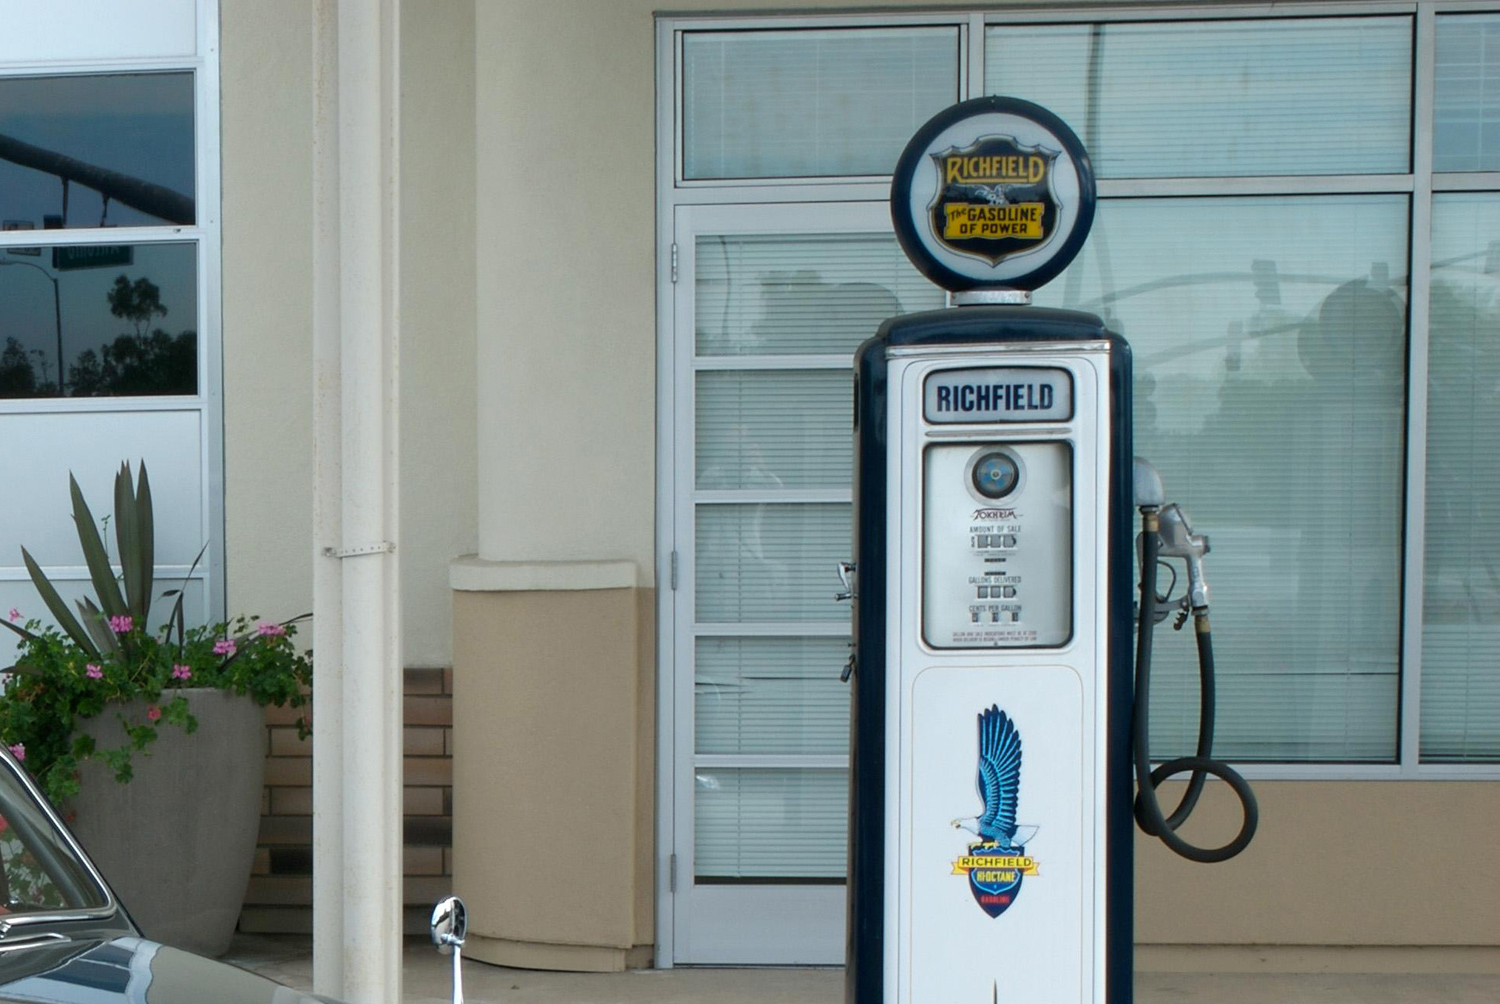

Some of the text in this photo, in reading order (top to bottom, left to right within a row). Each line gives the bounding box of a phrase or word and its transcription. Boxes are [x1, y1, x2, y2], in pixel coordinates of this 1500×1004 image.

[947, 156, 1045, 184] RICHFIELD
[951, 208, 1037, 222] The GASOLINE
[960, 223, 1028, 234] OF POWER
[937, 384, 1053, 412] RICHFIELD
[969, 525, 1021, 533] AMOUNT OF SALE
[968, 576, 1022, 584] GALLONS DELIVERED
[968, 604, 1022, 612] CENTS PER GALLON
[962, 857, 1032, 867] RICHFIELD
